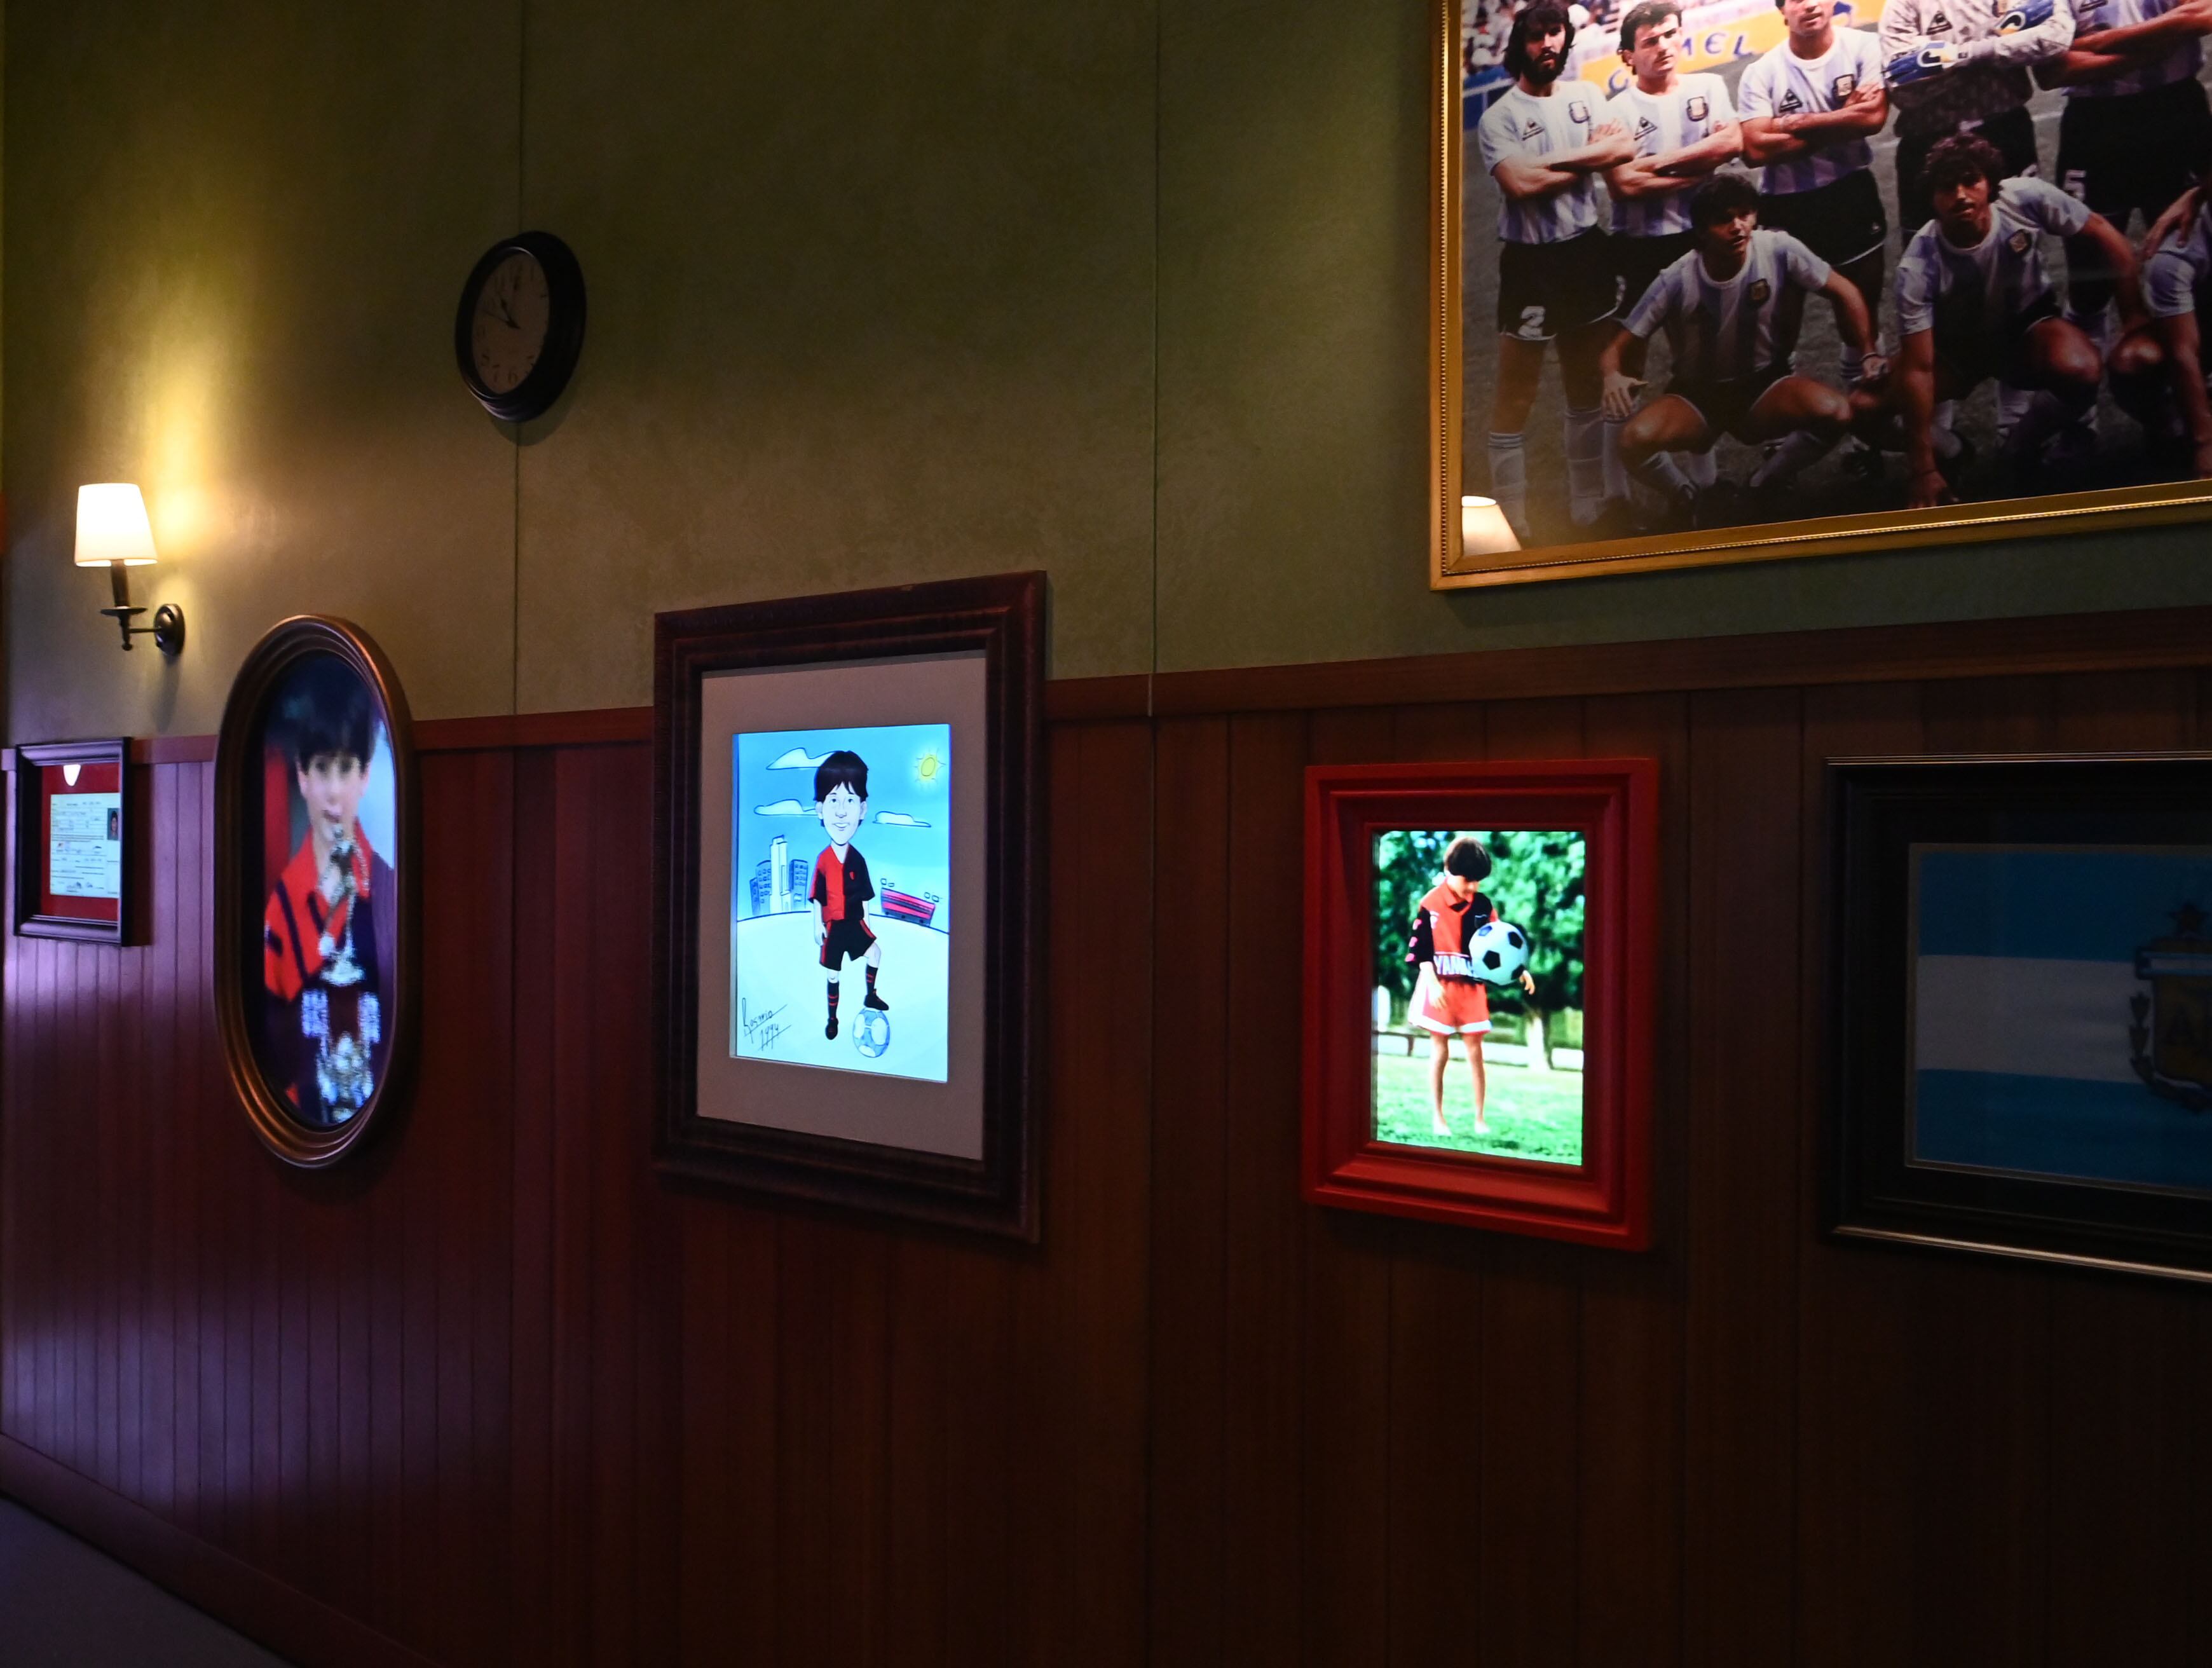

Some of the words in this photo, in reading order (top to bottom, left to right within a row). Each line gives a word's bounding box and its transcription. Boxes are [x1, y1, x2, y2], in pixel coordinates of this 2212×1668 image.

[1607, 31, 1753, 93] CEL
[2064, 169, 2086, 202] 5
[1517, 305, 1546, 337] 2
